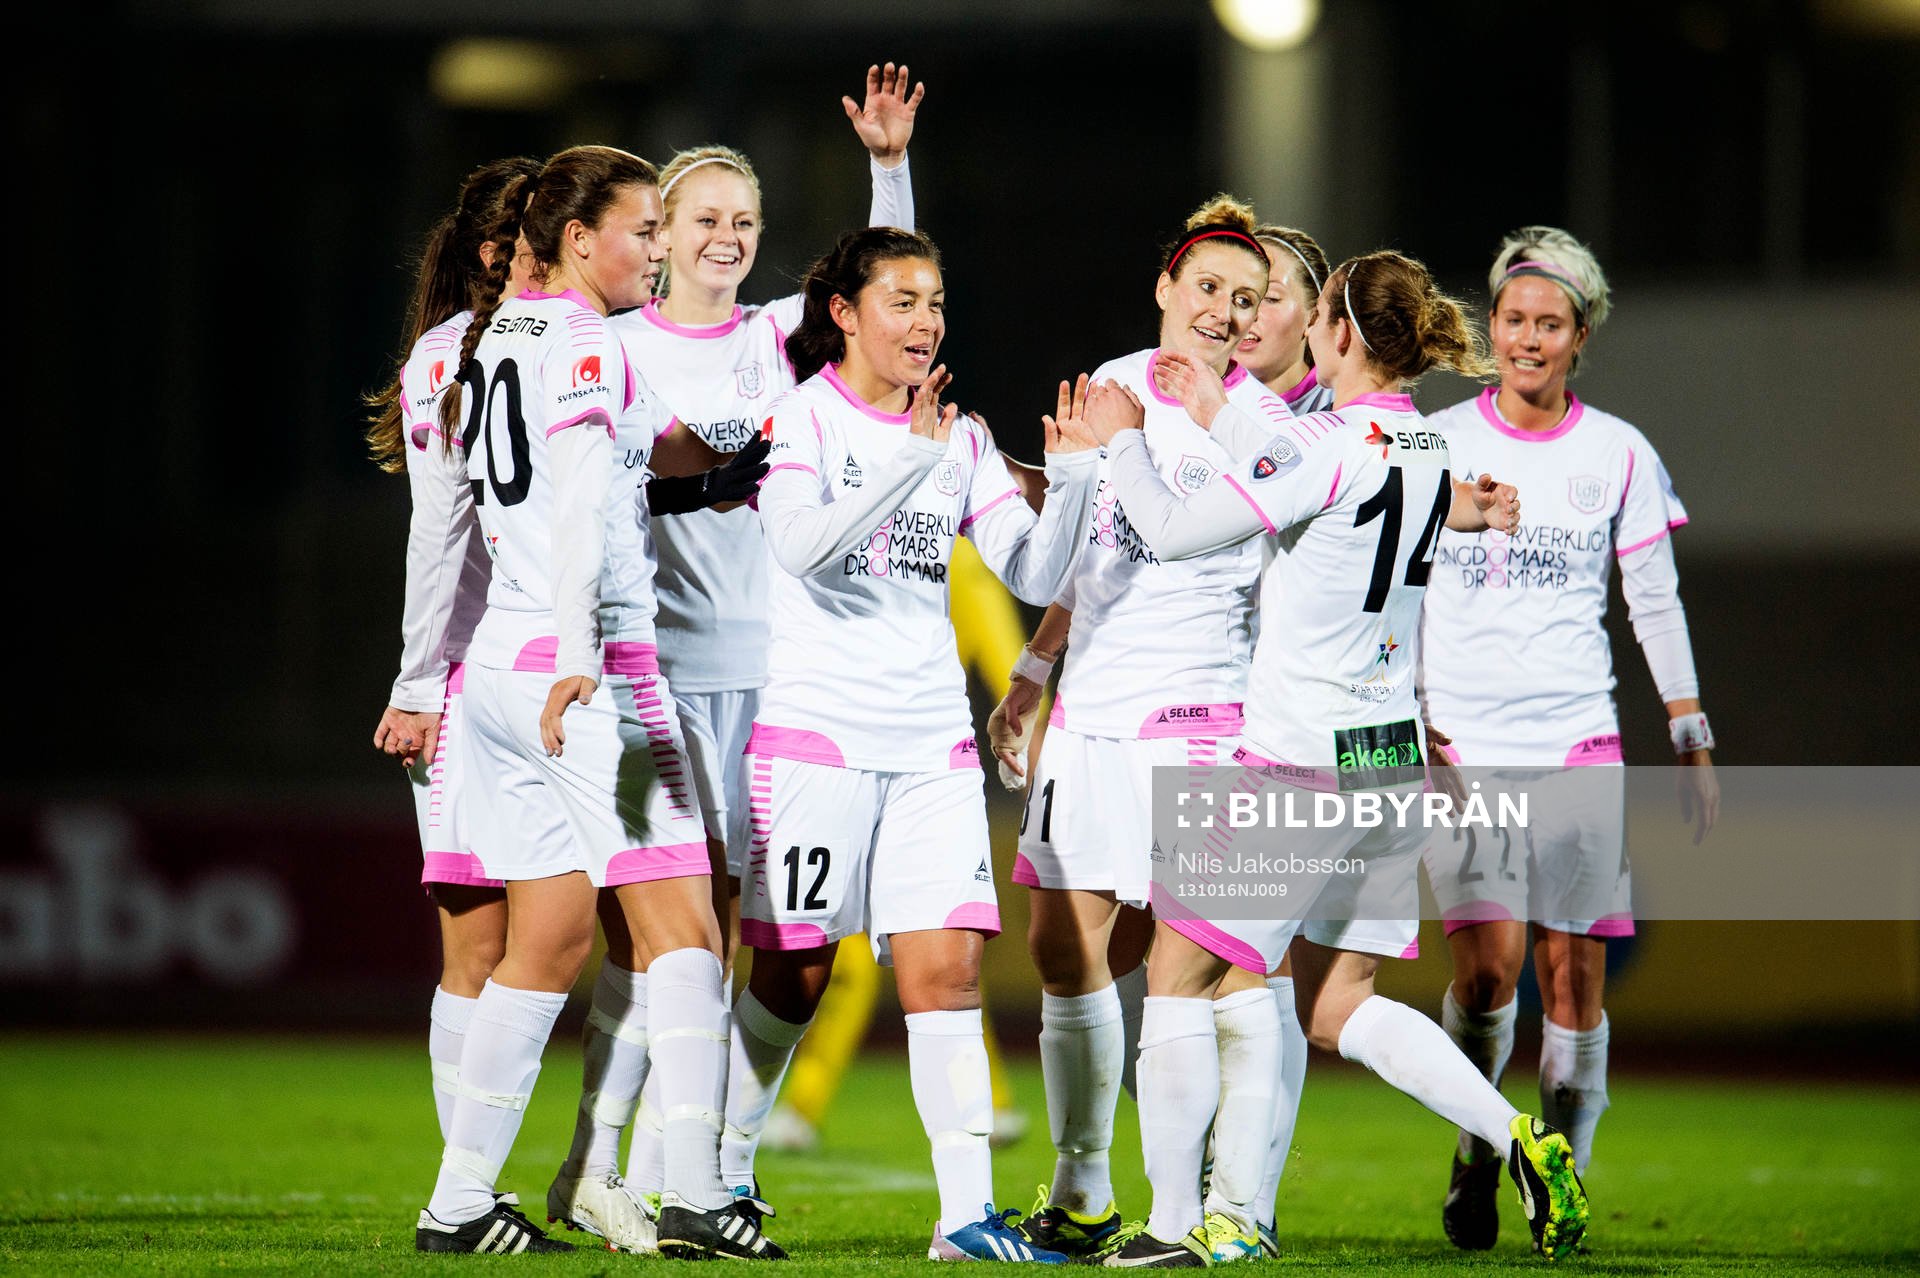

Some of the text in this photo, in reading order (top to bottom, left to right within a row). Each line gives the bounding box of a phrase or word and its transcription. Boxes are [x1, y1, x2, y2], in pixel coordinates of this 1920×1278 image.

[557, 387, 594, 404] SVENSKA
[458, 358, 533, 507] 20
[1353, 466, 1452, 613] 14
[1169, 707, 1209, 718] SELECT
[1274, 764, 1316, 778] SELECT
[1340, 743, 1399, 774] akea
[784, 846, 831, 911] 12
